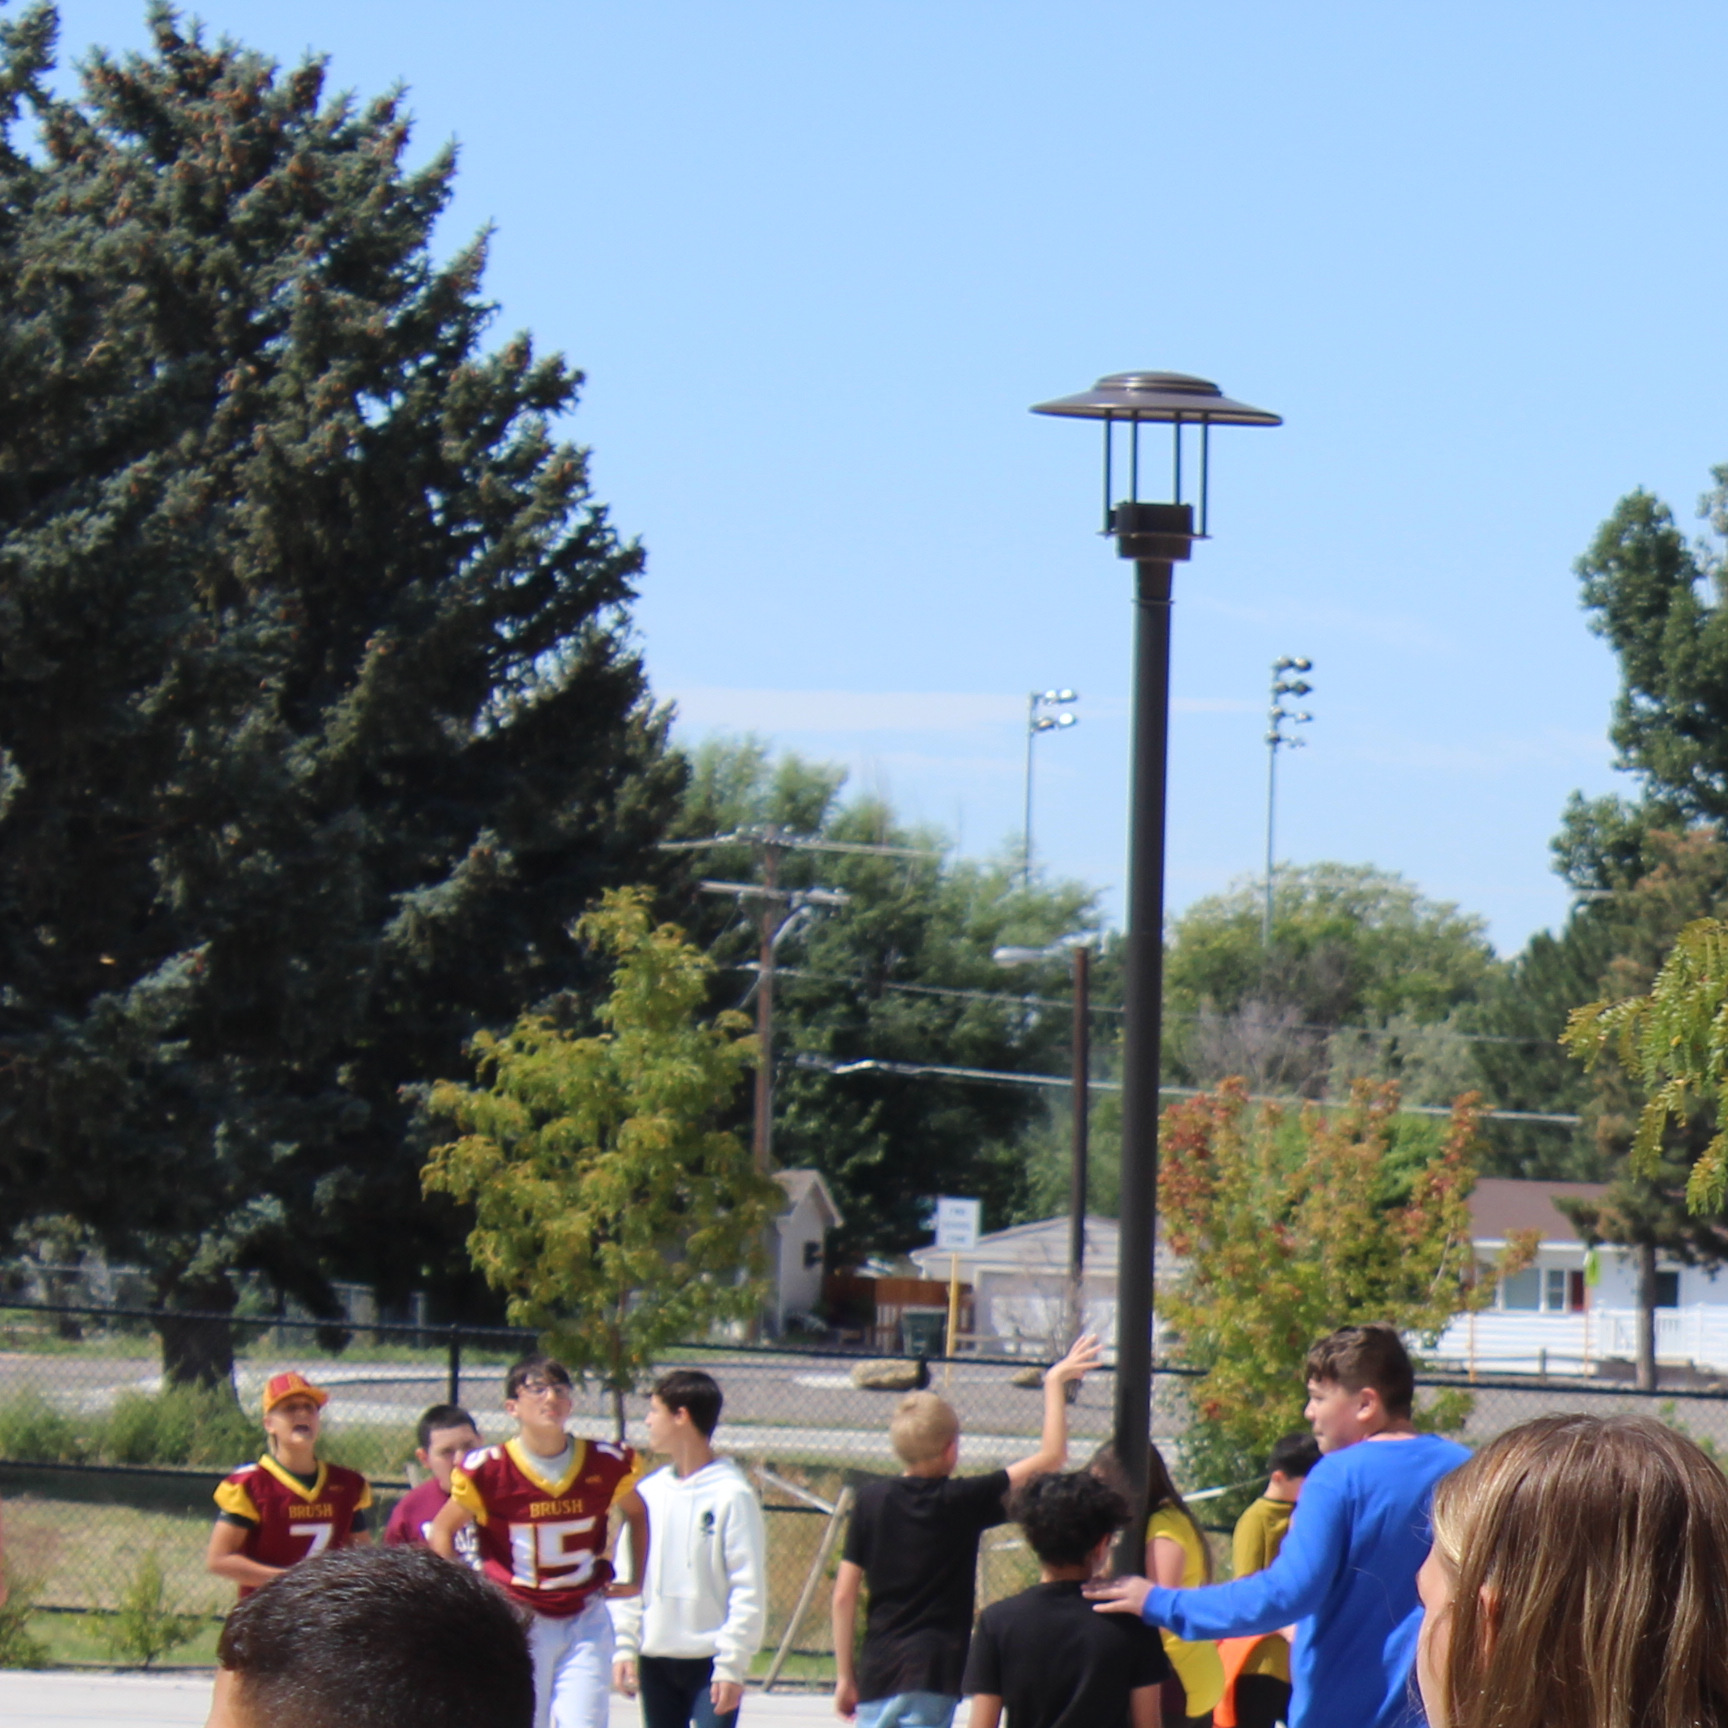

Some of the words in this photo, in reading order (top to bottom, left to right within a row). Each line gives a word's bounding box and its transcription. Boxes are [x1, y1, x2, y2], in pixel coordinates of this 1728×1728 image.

[289, 1503, 333, 1519] BRUSH
[529, 1499, 584, 1519] BRUSH
[289, 1523, 333, 1559] 7
[508, 1516, 597, 1590] 15
